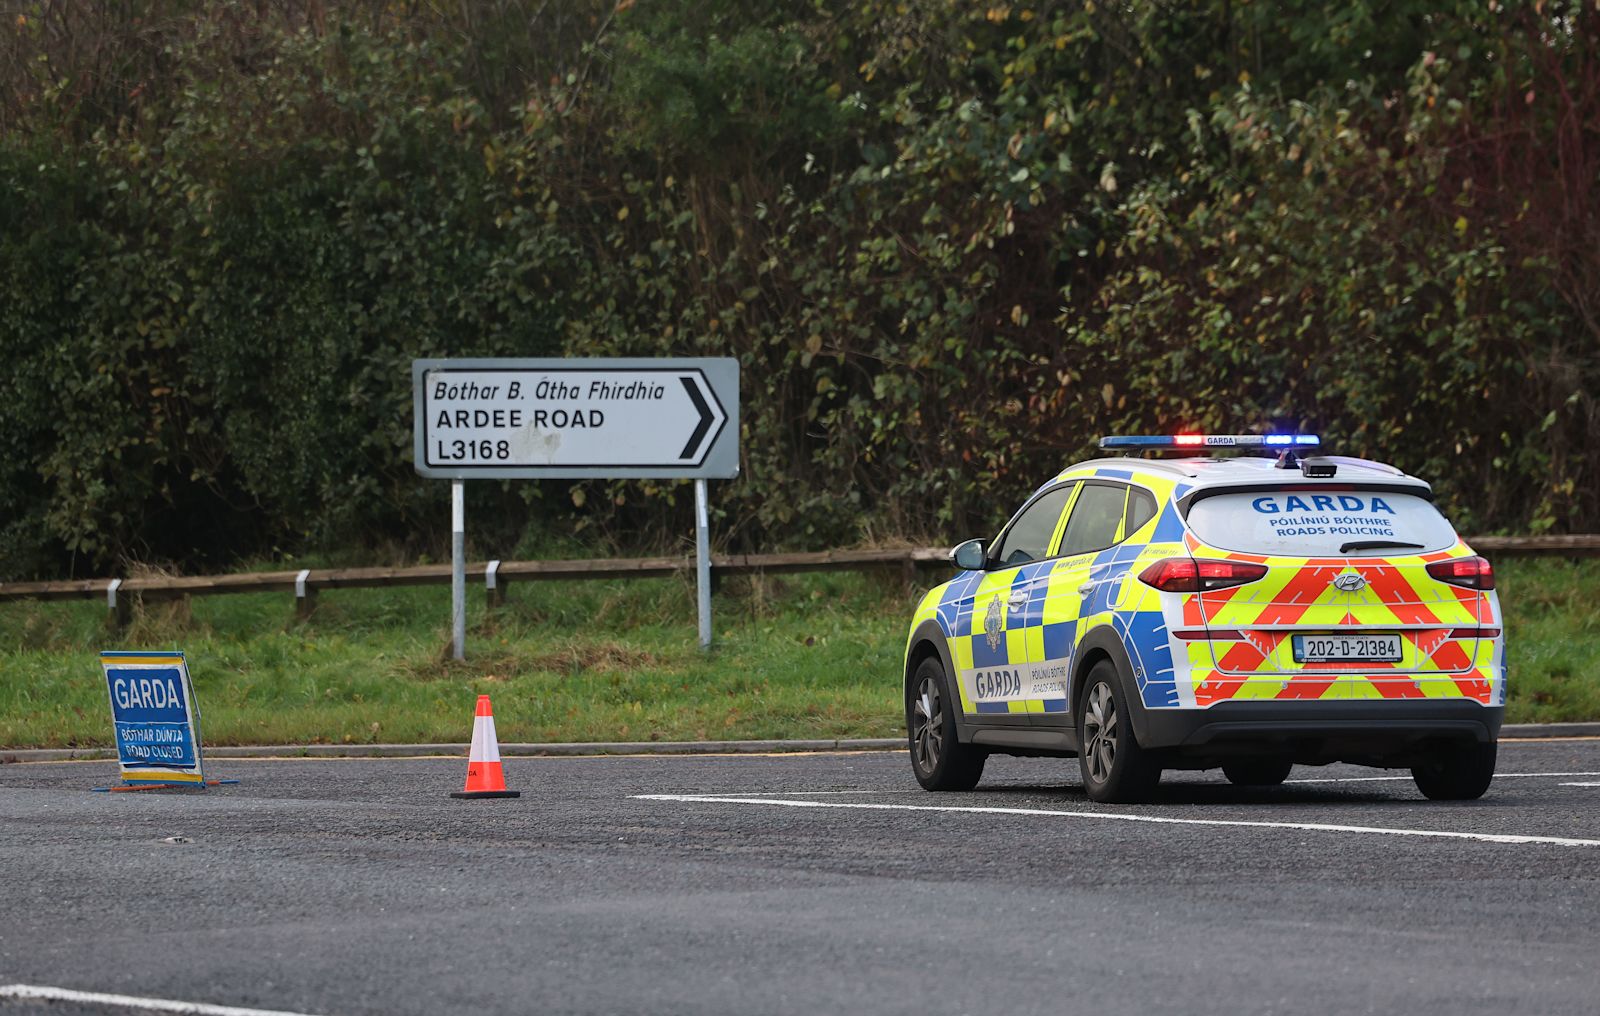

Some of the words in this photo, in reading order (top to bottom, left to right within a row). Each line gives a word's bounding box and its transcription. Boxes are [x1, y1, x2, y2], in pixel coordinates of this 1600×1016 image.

[433, 381, 499, 400] Bóthar
[507, 381, 526, 400] B.
[535, 376, 580, 400] Átha
[588, 381, 665, 400] Fhirdhia
[437, 410, 523, 428] ARDEE
[534, 410, 605, 428] ROAD
[438, 440, 510, 460] L3168
[1252, 495, 1397, 515] GARDA
[1269, 515, 1330, 527] PÓILÍNIÚ
[1333, 515, 1392, 527] BÓITHRE
[1276, 526, 1326, 537] ROADS
[1329, 526, 1394, 537] POLICING
[1307, 640, 1396, 656] 202-D-21384
[976, 669, 1021, 699] GARDA
[114, 678, 181, 709] GARDA
[121, 727, 154, 741] BÓTHAR
[155, 726, 183, 742] DÚNTA
[125, 745, 150, 758] ROAD
[151, 745, 184, 759] CLOSED
